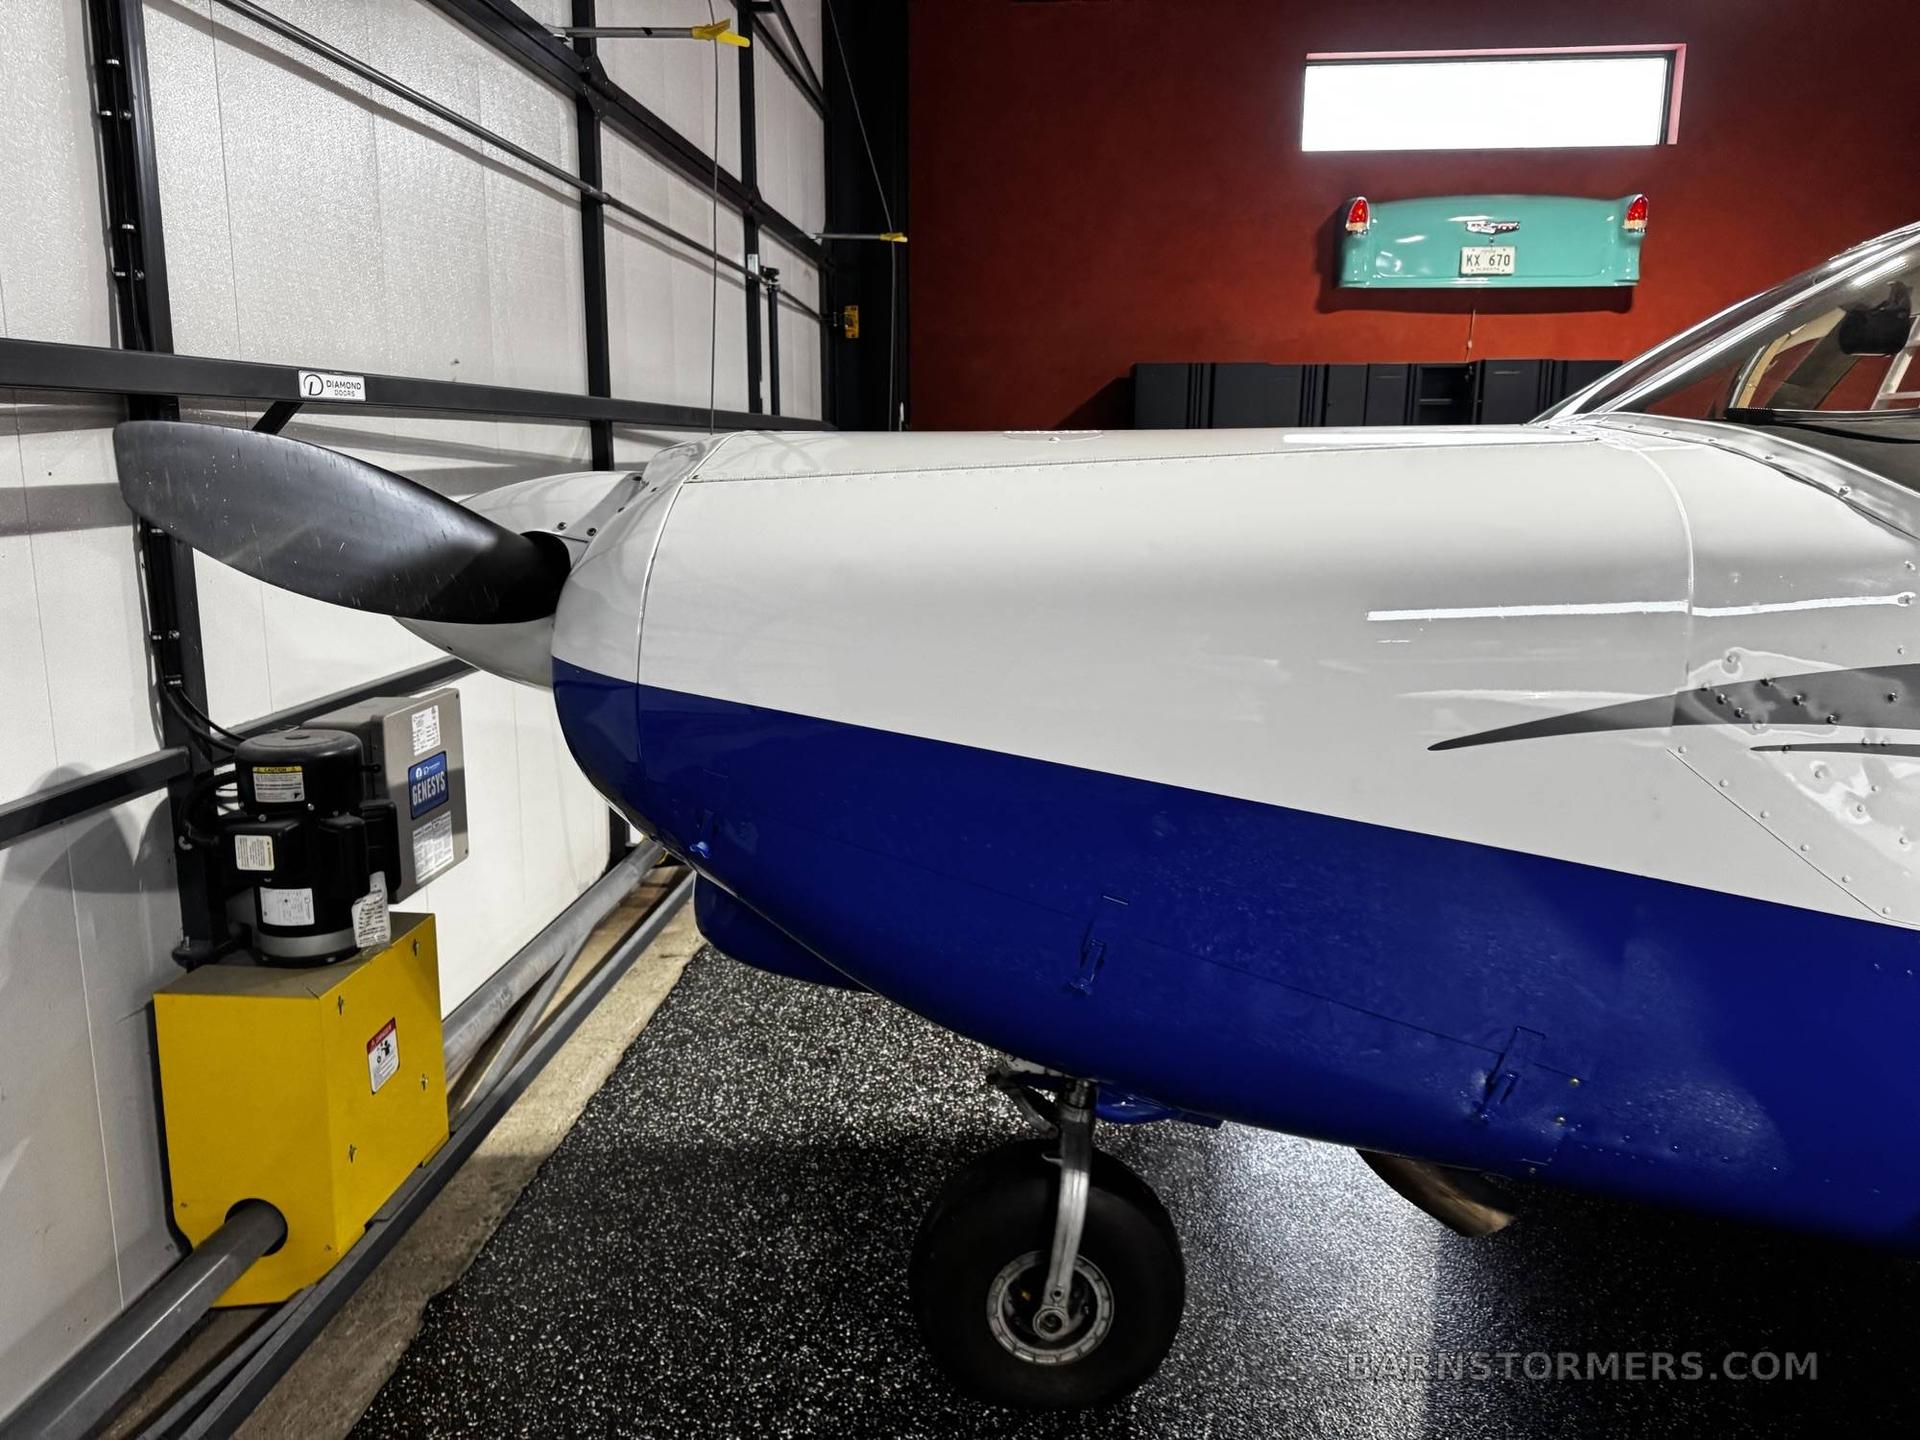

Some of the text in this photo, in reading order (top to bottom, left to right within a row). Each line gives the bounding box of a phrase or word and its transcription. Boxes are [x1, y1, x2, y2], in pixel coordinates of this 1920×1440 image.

[1466, 254, 1511, 267] KX 670
[326, 379, 361, 390] DIAMOND
[334, 389, 355, 397] DOORS
[411, 771, 446, 806] GENESYS
